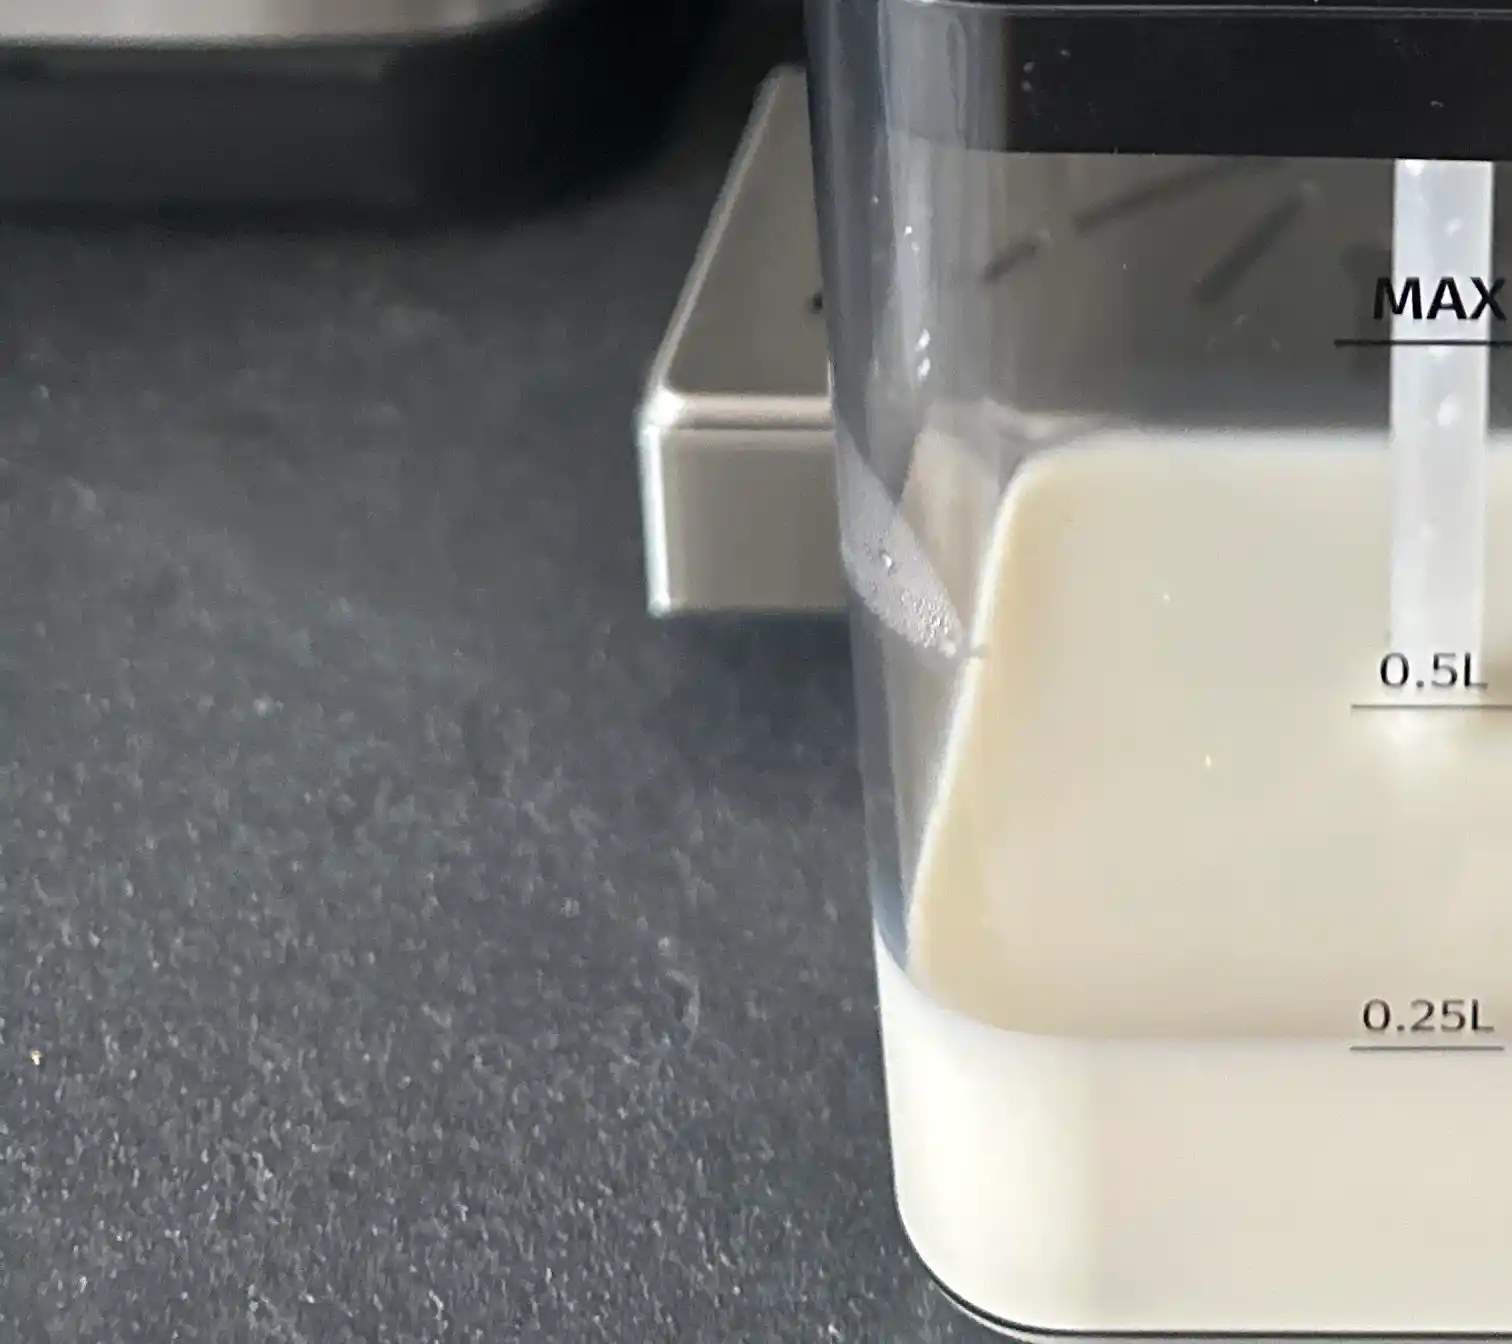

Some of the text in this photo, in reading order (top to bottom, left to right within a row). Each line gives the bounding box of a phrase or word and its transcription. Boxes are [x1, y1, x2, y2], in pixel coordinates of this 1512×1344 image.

[1372, 275, 1508, 321] MAX
[1378, 652, 1490, 690] 0.5L
[1361, 998, 1495, 1033] 0.25L
